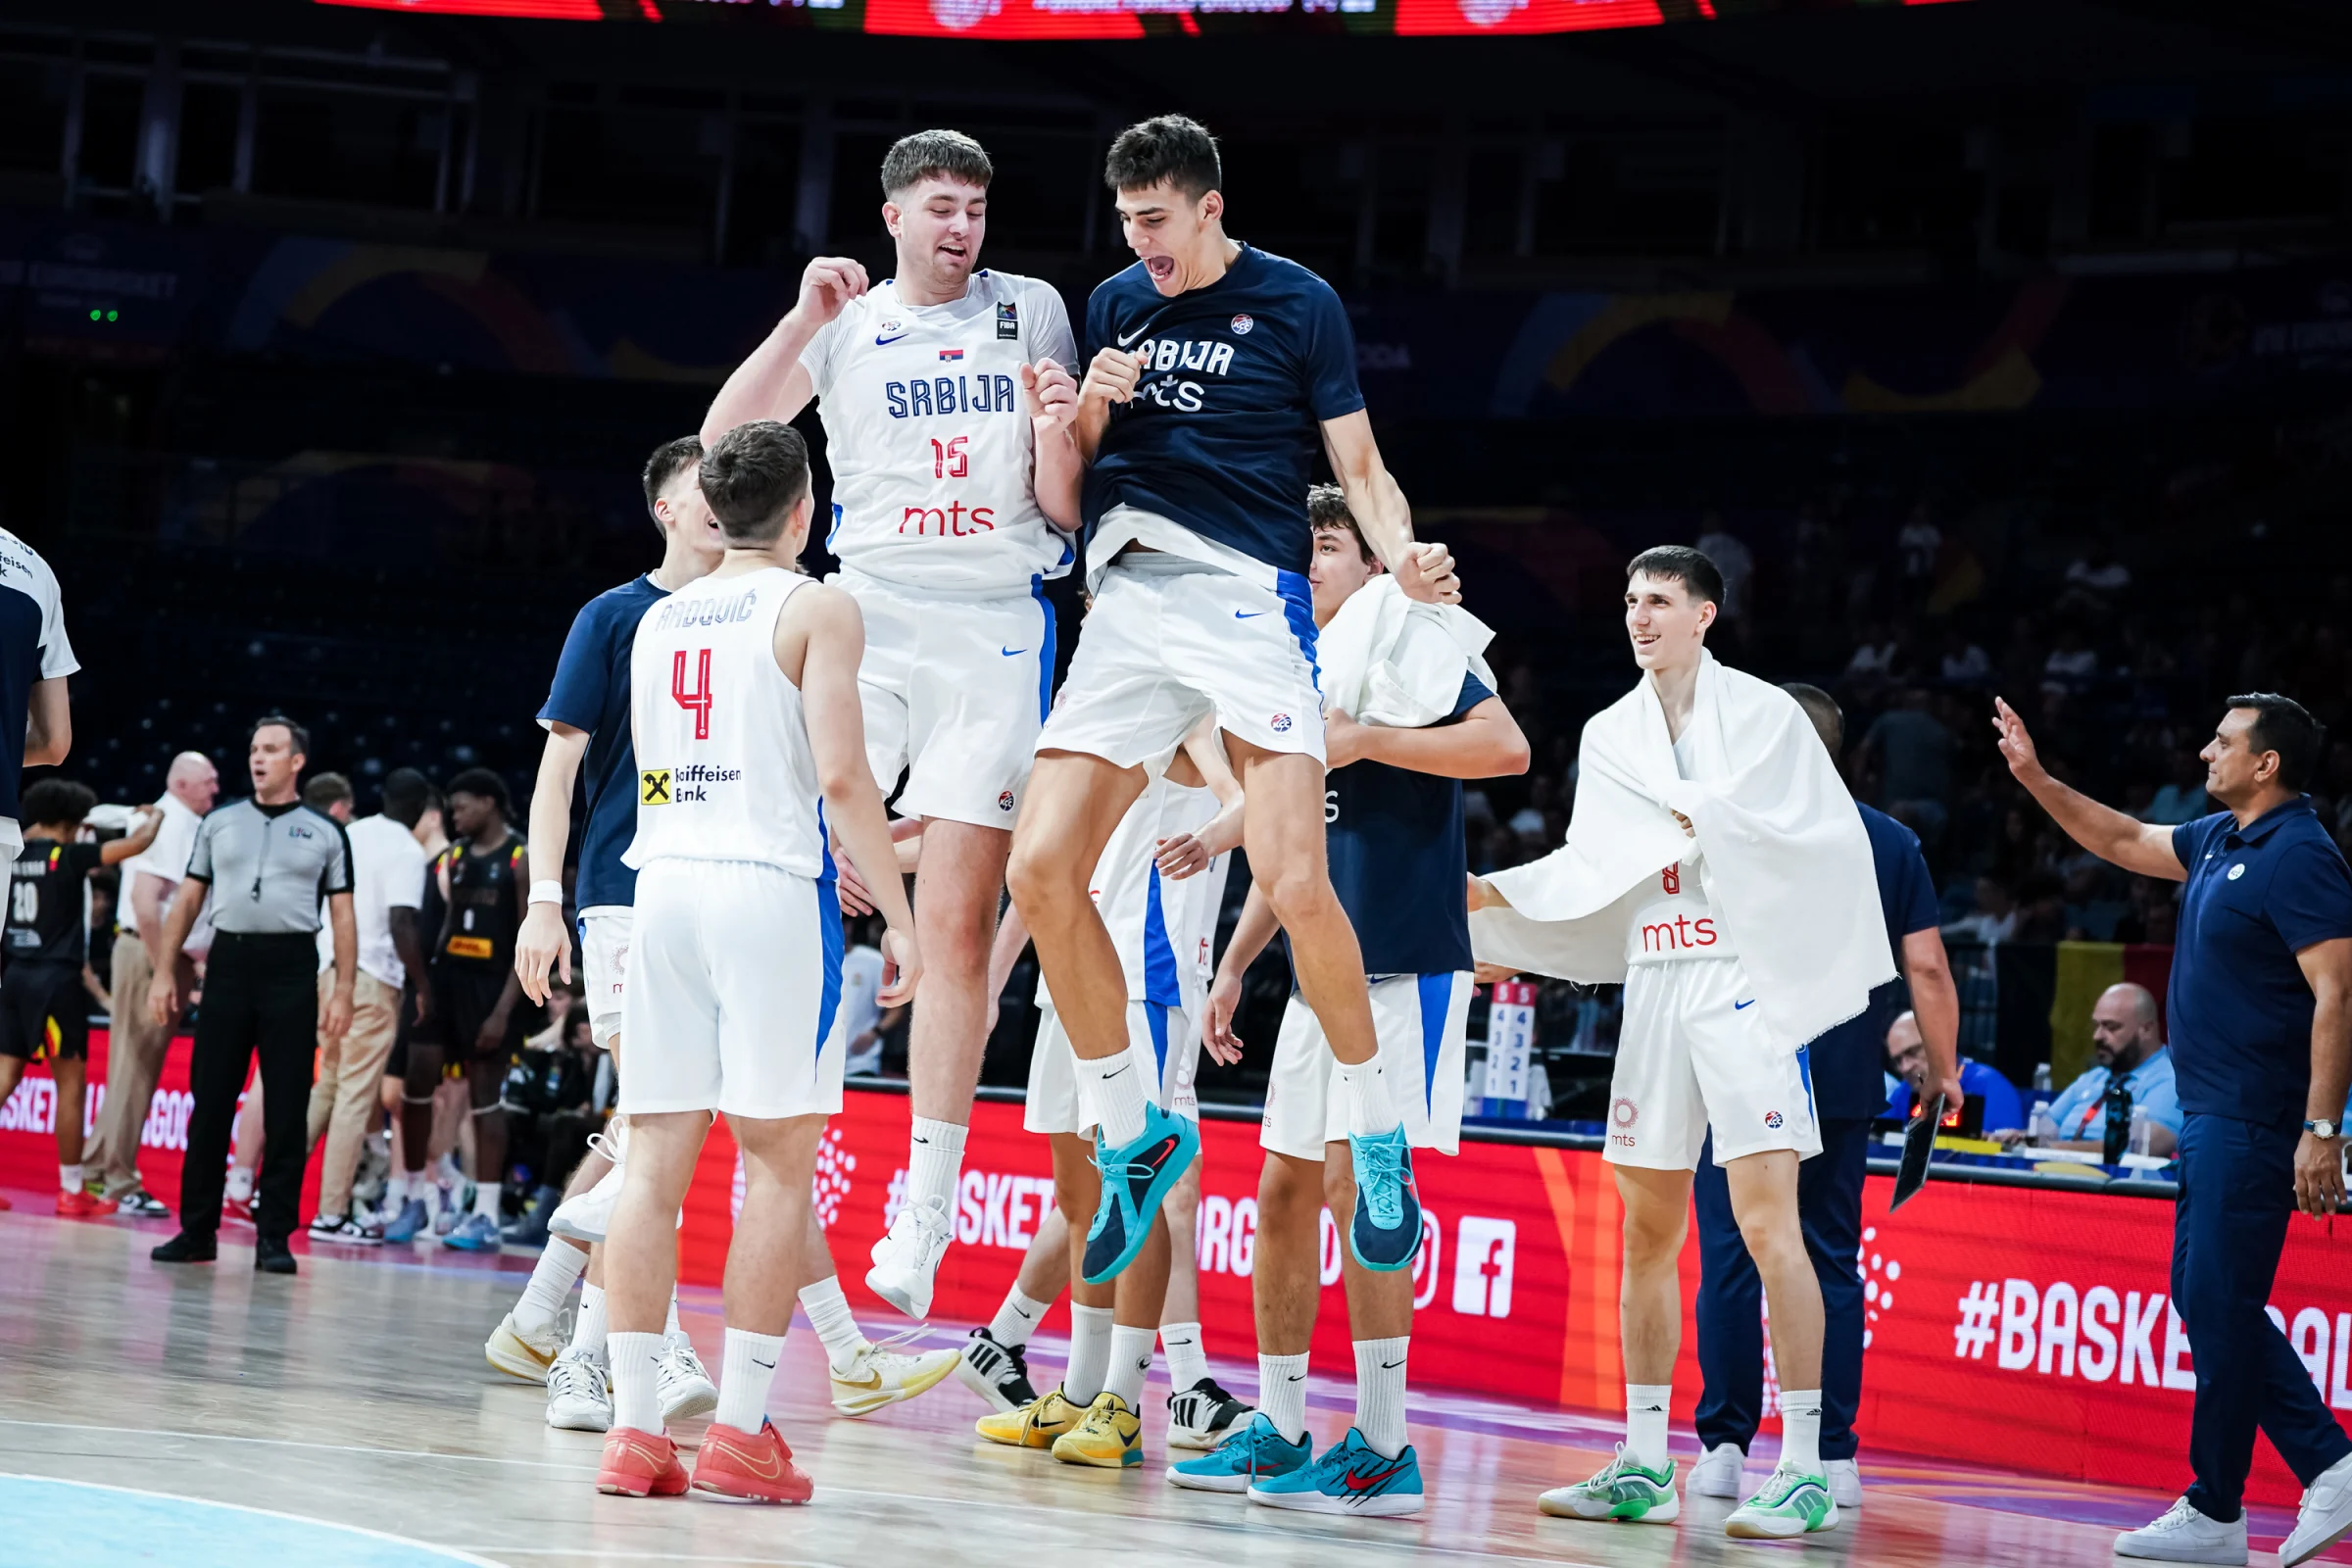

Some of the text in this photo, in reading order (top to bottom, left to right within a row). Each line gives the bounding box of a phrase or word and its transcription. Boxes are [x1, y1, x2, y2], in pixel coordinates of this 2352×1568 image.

[1127, 339, 1235, 376] RBIJA
[886, 374, 1015, 418] SRBIJA
[931, 436, 968, 478] 15
[899, 500, 996, 537] mts
[672, 648, 712, 740] 4
[676, 784, 708, 803] Bnk
[1642, 914, 1717, 953] mts
[1517, 1011, 1527, 1024] 4
[1514, 1033, 1524, 1049] 3
[1510, 1056, 1521, 1071] 2
[1174, 1095, 1196, 1106] mts
[1612, 1133, 1636, 1148] mts
